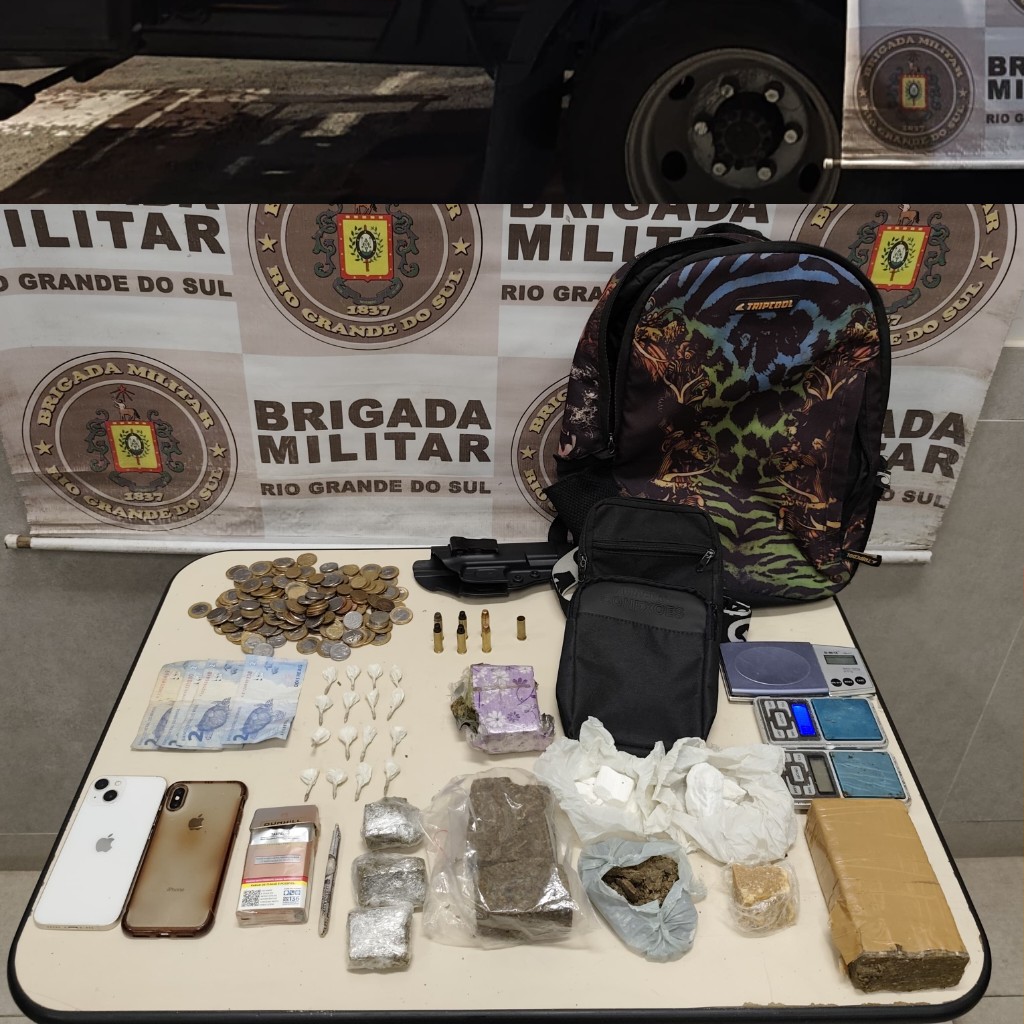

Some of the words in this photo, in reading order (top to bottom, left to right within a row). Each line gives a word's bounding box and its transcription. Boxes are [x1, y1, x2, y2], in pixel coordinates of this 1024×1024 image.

[863, 37, 914, 77] BRIGADA
[917, 38, 963, 77] MILITAR
[931, 129, 946, 141] DO
[949, 104, 965, 129] SUL
[986, 113, 1009, 123] RIO
[4, 209, 225, 254] ILITAR
[19, 274, 129, 291] GRANDE
[138, 276, 174, 293] DO
[182, 277, 232, 297] SUL
[267, 265, 301, 308] RIO
[302, 308, 398, 338] GRANDE
[402, 308, 432, 330] DO
[432, 267, 464, 310] SUL
[502, 285, 544, 301] RIO
[553, 286, 606, 302] GRA
[347, 306, 391, 316] 1837
[747, 300, 793, 311] TRIPCOOL
[908, 320, 939, 342] DO
[943, 281, 984, 322] SUL
[38, 362, 123, 427] BRIGADA
[127, 363, 216, 430] MILITAR
[254, 398, 491, 431] BRIGADA
[258, 432, 491, 464] MILITAR
[46, 465, 81, 495] RIO
[84, 495, 173, 520] GRANDE
[176, 498, 200, 515] DO
[200, 467, 224, 501] SUL
[124, 492, 165, 502] 1837
[261, 483, 300, 496] RIO
[309, 480, 402, 494] GRANDE
[411, 480, 440, 493] DO
[449, 481, 491, 494] SUL
[902, 490, 947, 508] SUL
